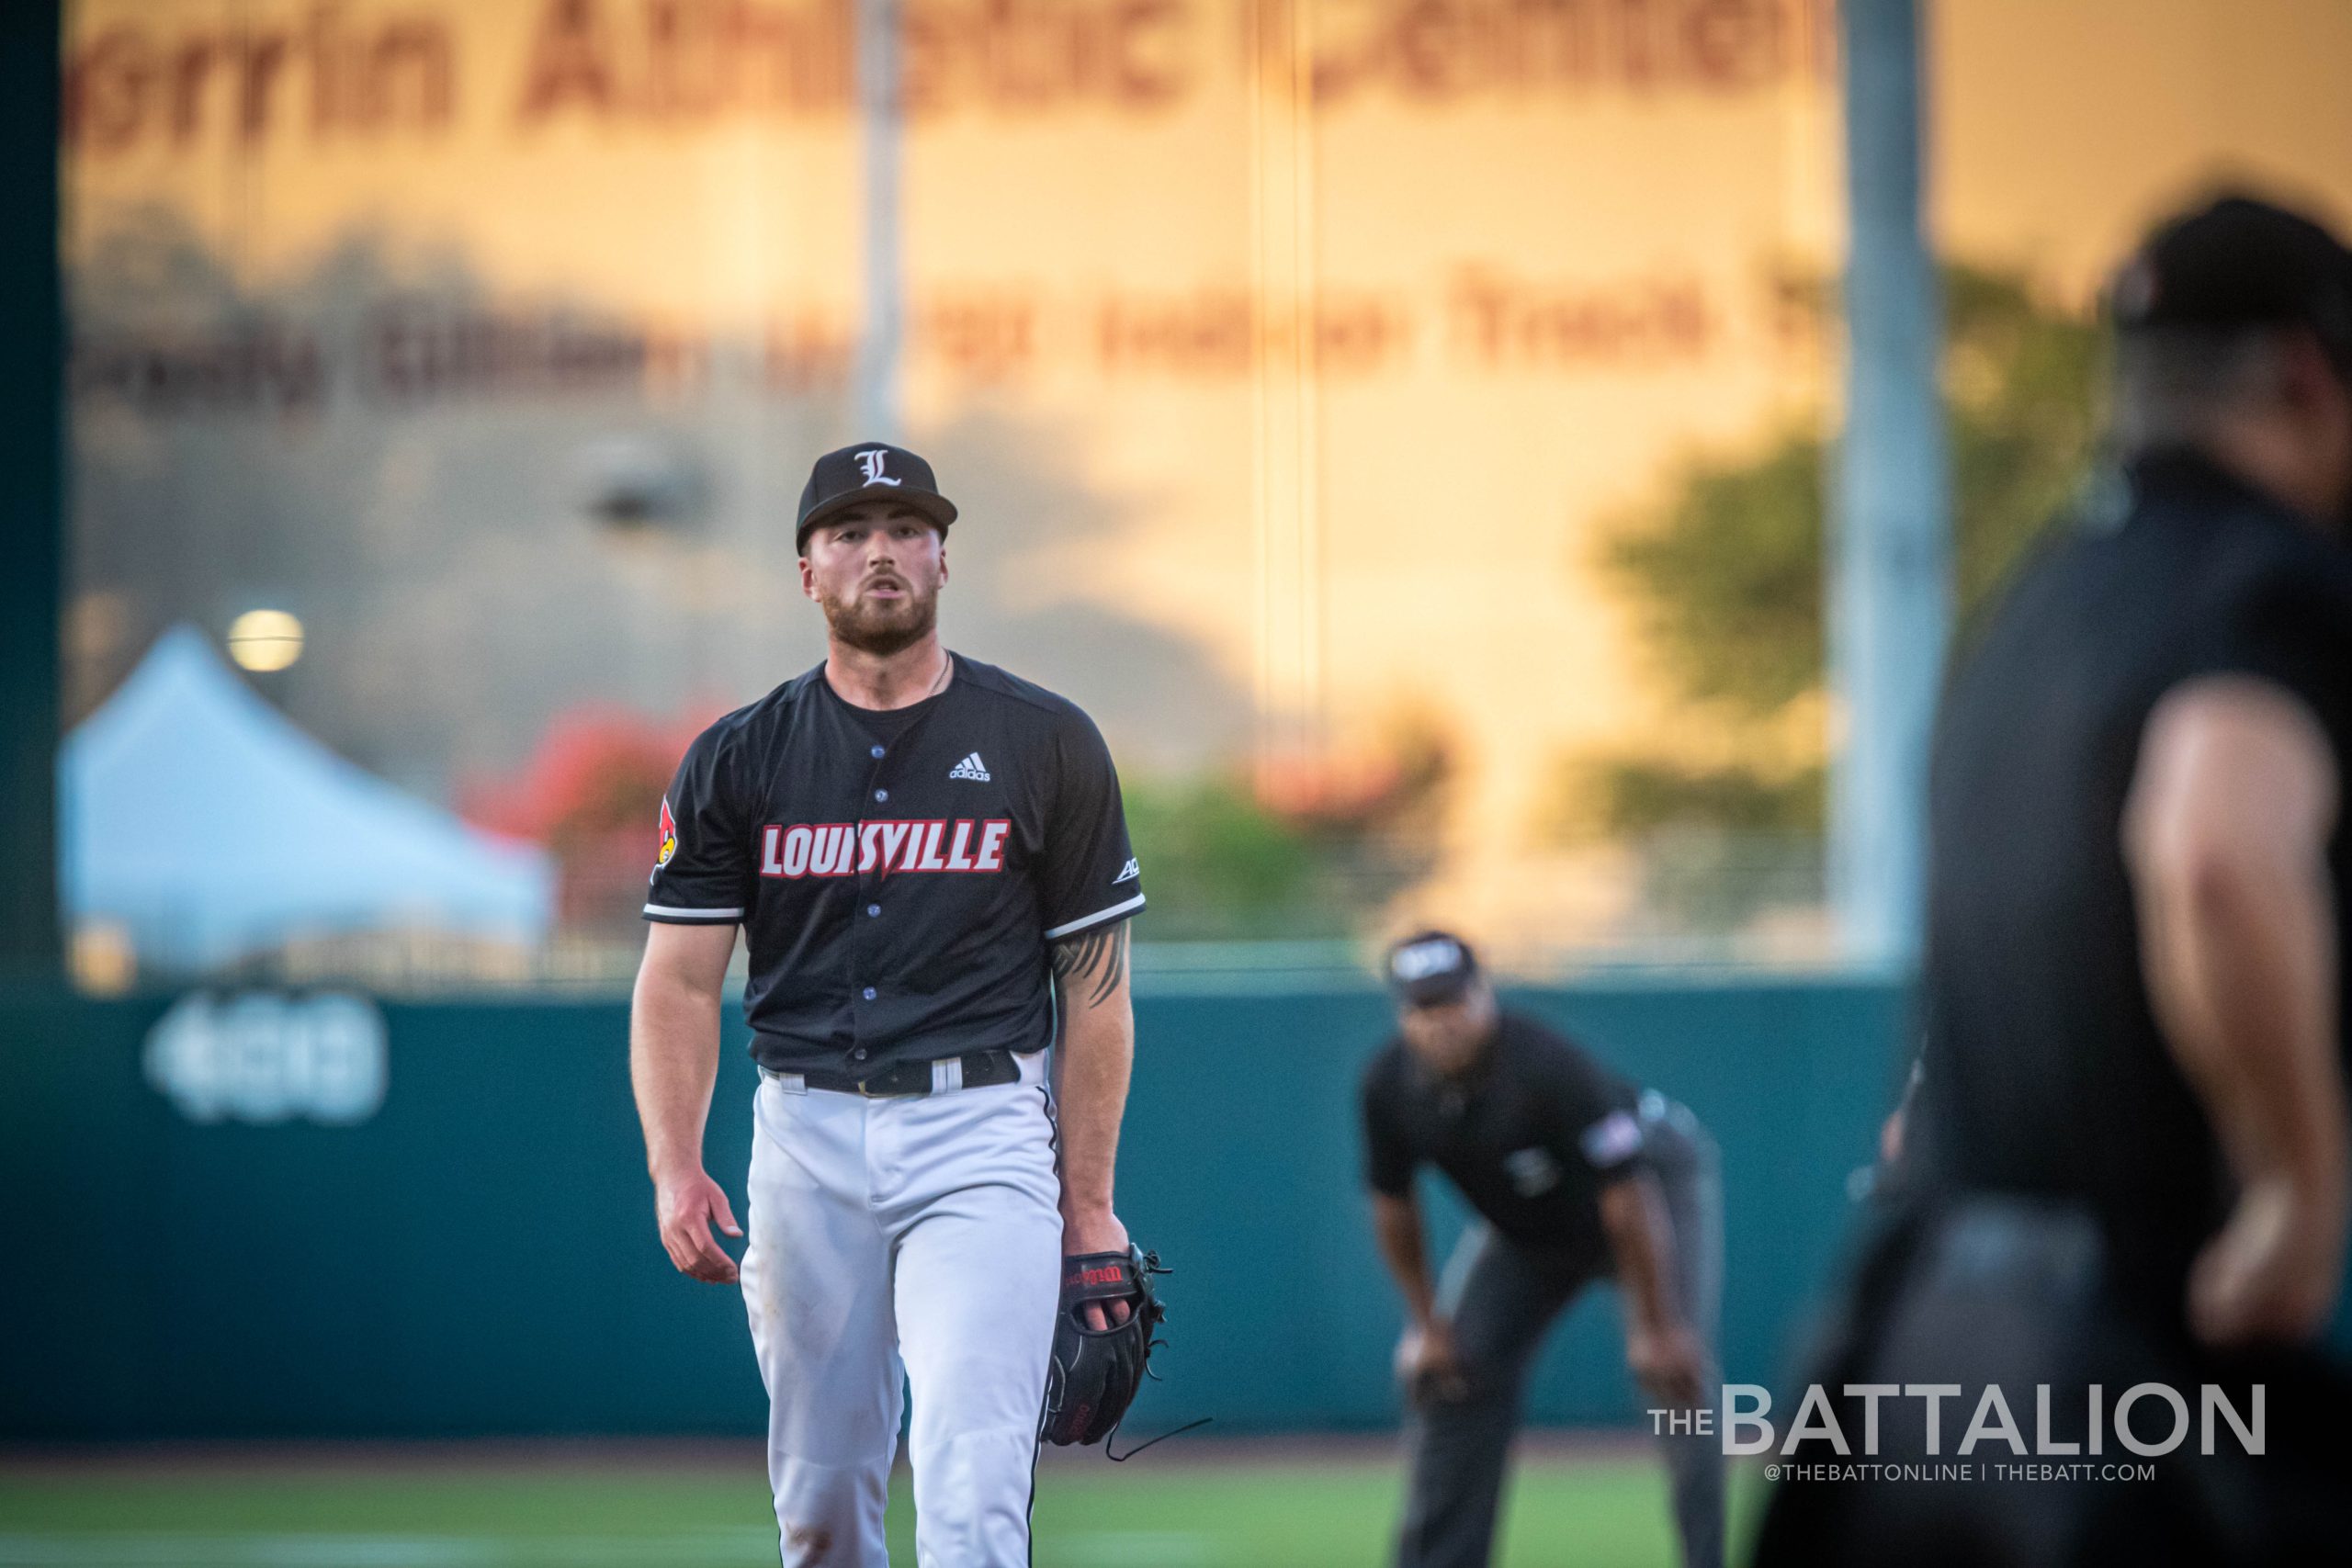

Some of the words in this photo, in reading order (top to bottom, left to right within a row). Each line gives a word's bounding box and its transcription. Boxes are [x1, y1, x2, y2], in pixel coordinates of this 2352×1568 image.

[854, 449, 892, 488] L
[949, 766, 990, 783] adidas
[761, 818, 1010, 881] LOUISVILLE
